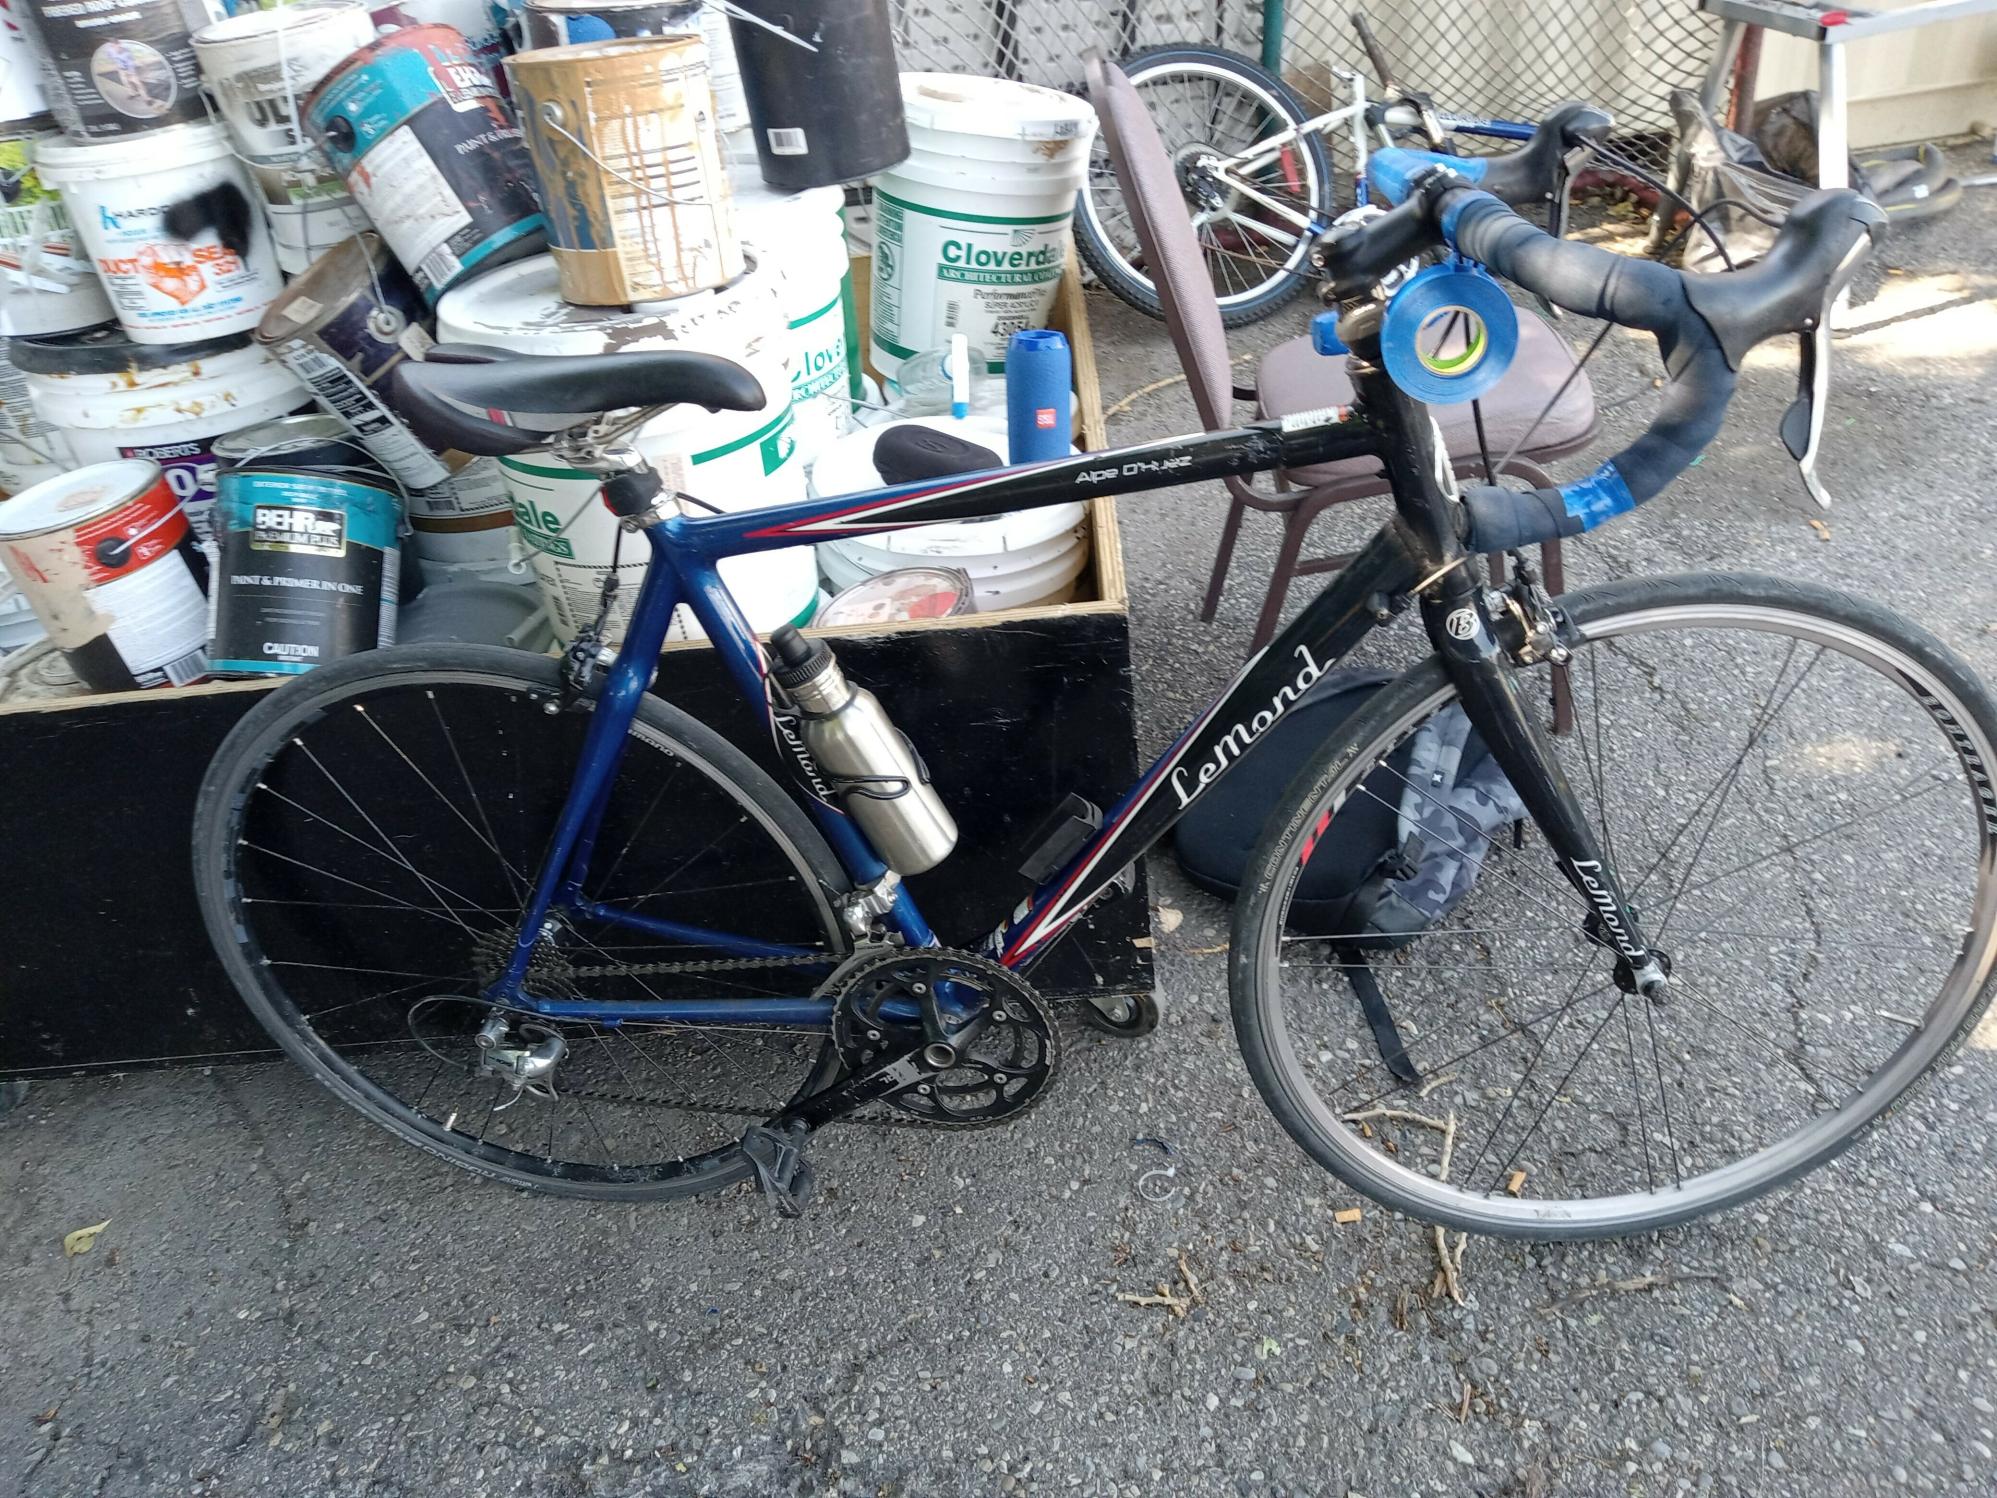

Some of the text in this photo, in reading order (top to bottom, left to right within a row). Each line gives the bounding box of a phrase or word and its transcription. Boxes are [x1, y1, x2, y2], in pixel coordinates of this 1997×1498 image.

[134, 443, 201, 459] ROBERTS
[1075, 467, 1120, 485] Alpe
[256, 508, 316, 531] BEHR
[231, 575, 261, 586] PAINT
[272, 577, 321, 590] PRIMER
[262, 642, 320, 657] CAUTION
